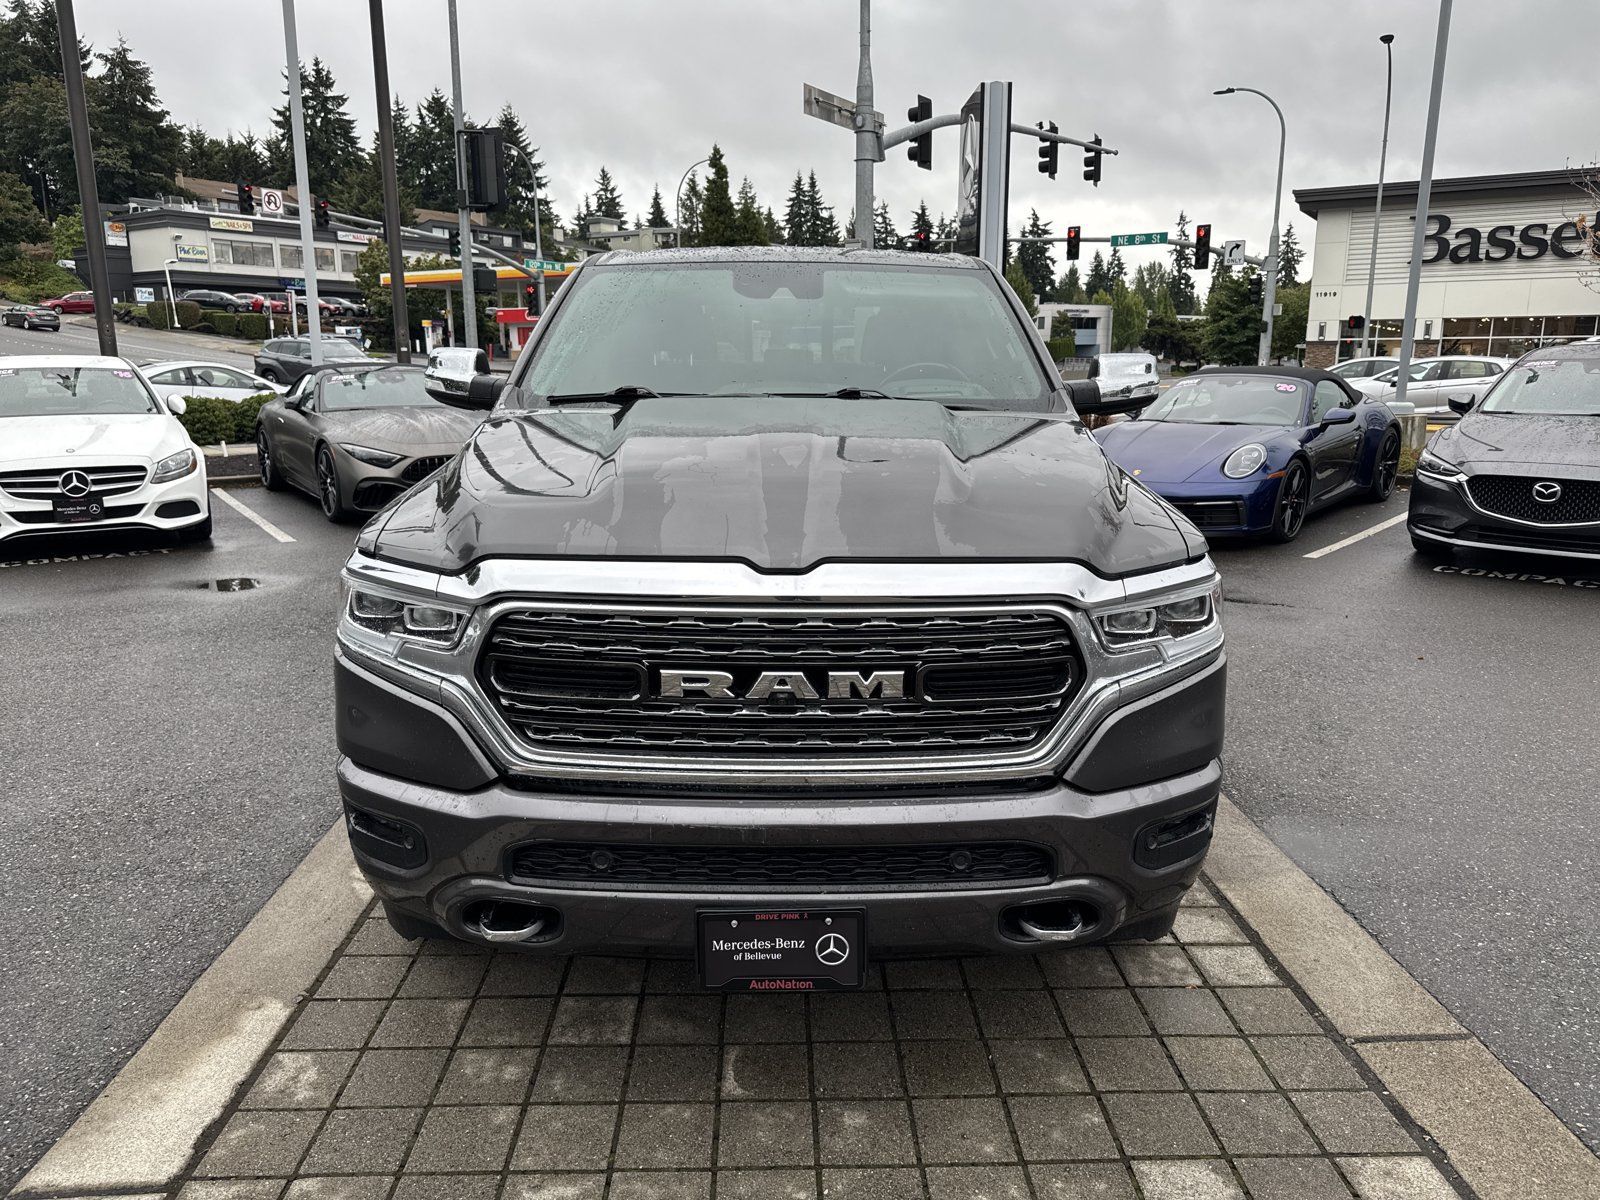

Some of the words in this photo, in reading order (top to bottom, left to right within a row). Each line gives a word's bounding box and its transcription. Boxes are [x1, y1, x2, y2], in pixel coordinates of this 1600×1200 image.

[1118, 236, 1129, 245] NE
[1134, 235, 1145, 244] 8th
[1152, 234, 1160, 243] St
[660, 670, 904, 698] RAM
[712, 938, 805, 950] Mercedes-Benz
[744, 952, 782, 960] Bellevue
[749, 980, 813, 989] AutoNation
